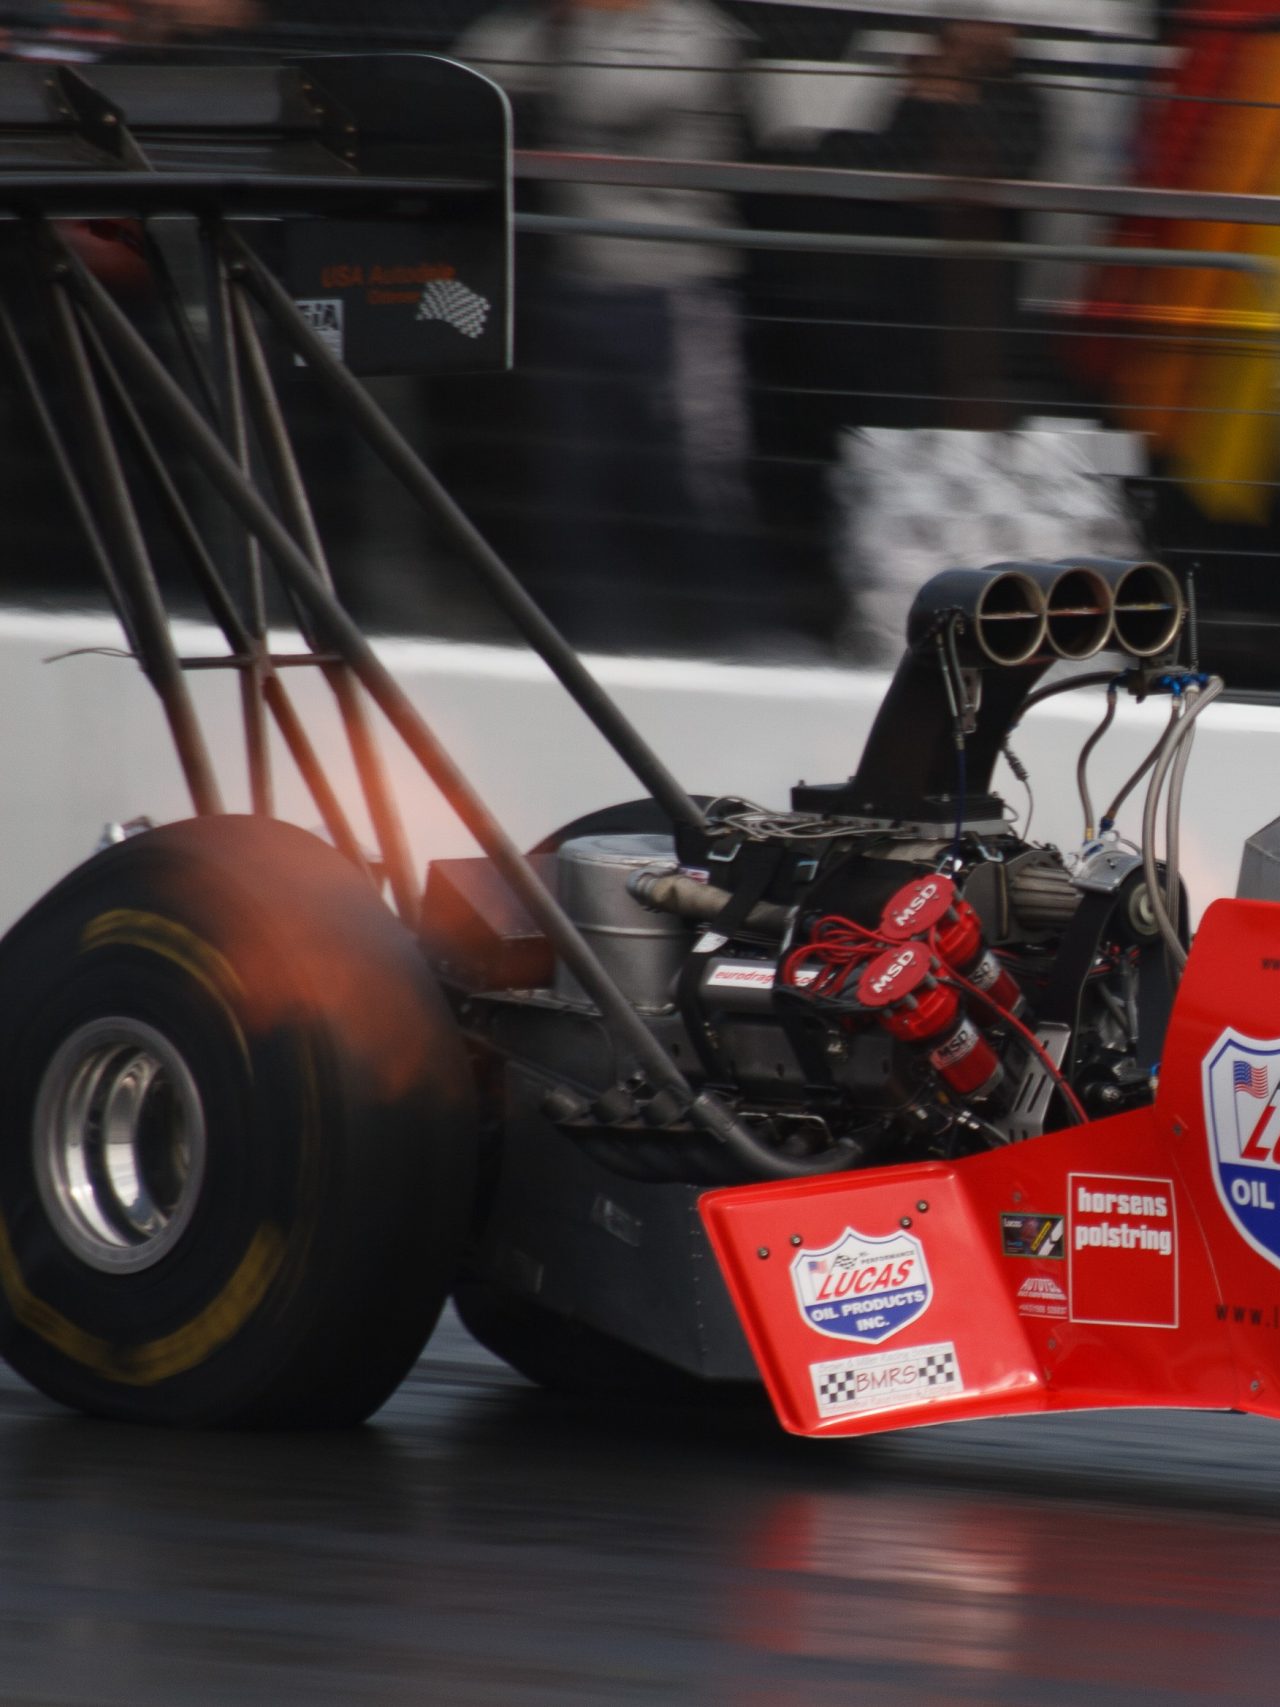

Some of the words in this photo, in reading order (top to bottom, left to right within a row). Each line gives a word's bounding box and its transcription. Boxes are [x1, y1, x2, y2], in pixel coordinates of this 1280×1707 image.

[895, 883, 937, 927] MSD
[872, 950, 915, 994] MSD
[1078, 1187, 1167, 1217] horsens
[1231, 1178, 1275, 1210] OIL
[1075, 1222, 1171, 1256] polstring
[816, 1259, 914, 1301] LUCAS
[811, 1307, 839, 1322] OIL
[841, 1290, 925, 1316] PRODUCTS
[856, 1316, 890, 1332] INC.
[855, 1365, 918, 1393] BMRS
